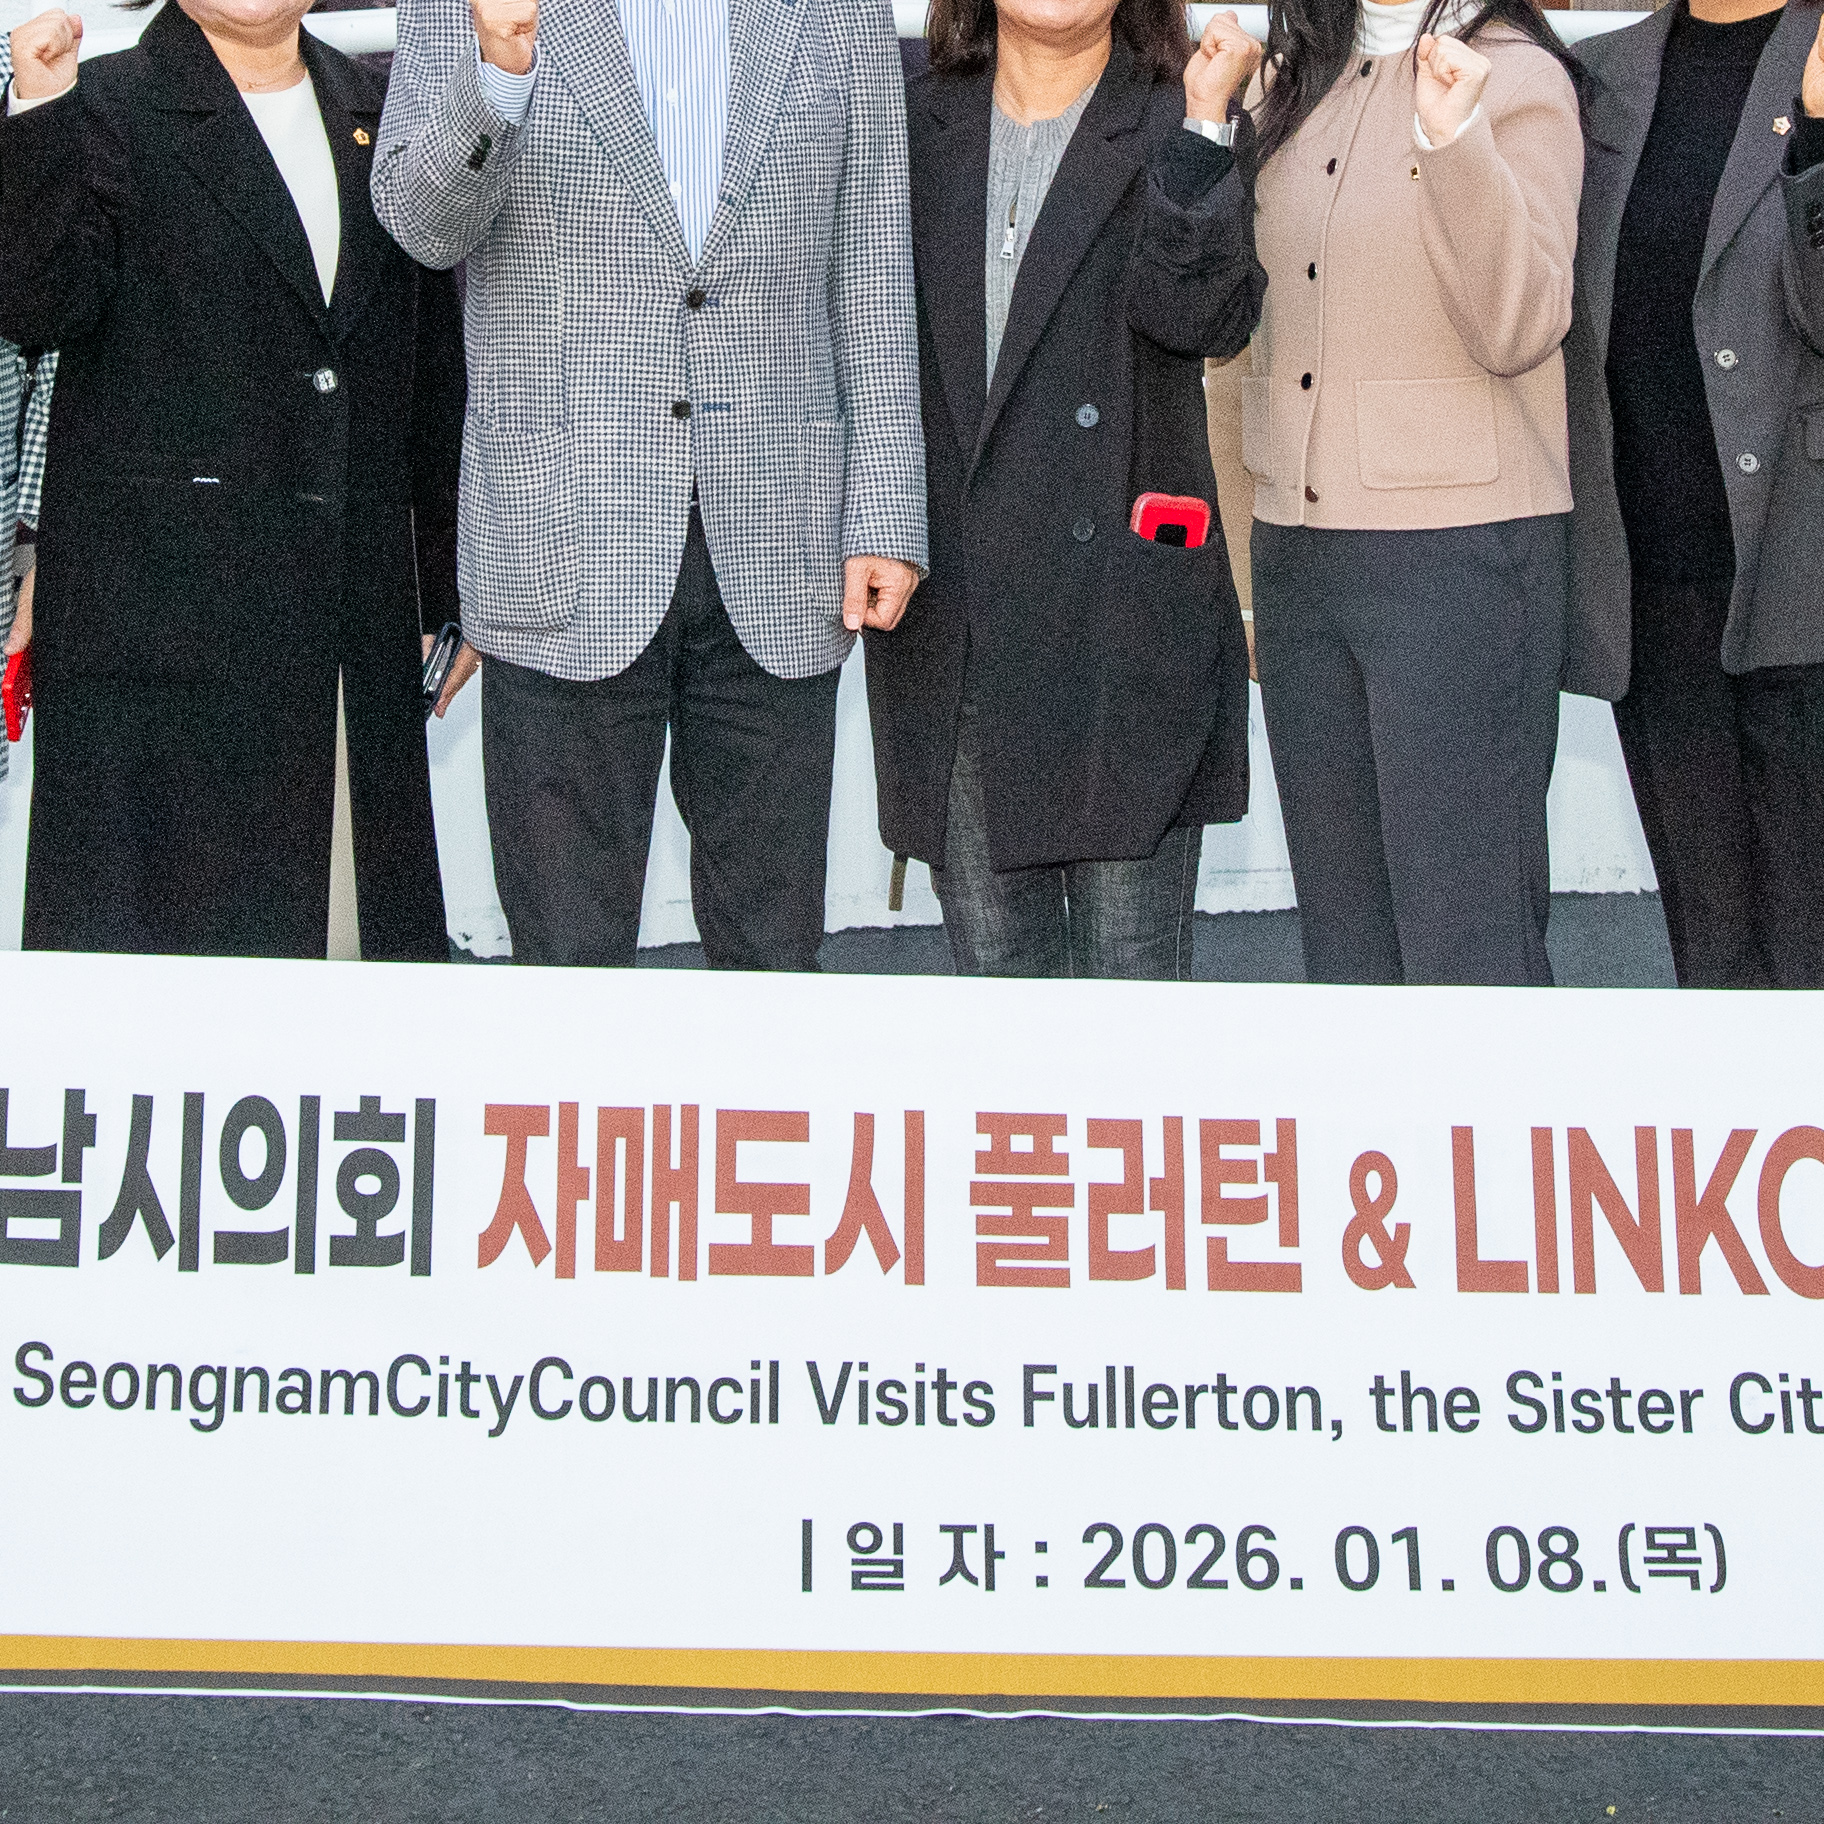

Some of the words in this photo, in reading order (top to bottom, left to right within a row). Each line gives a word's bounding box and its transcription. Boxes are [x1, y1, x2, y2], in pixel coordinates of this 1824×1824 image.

[478, 1102, 925, 1285] 자매도시
[970, 1112, 1302, 1293] 풀러턴
[1342, 1151, 1415, 1291] &
[13, 1341, 779, 1438] SeongnamCityCouncil
[806, 1361, 995, 1428] Visits
[1023, 1364, 1342, 1442] Fullerton,
[1369, 1370, 1481, 1434] the
[1506, 1370, 1704, 1434] Sister
[847, 1522, 904, 1591] 일
[939, 1524, 1005, 1592] 자
[1082, 1522, 1303, 1591] 2026.
[1335, 1525, 1455, 1592] 01.
